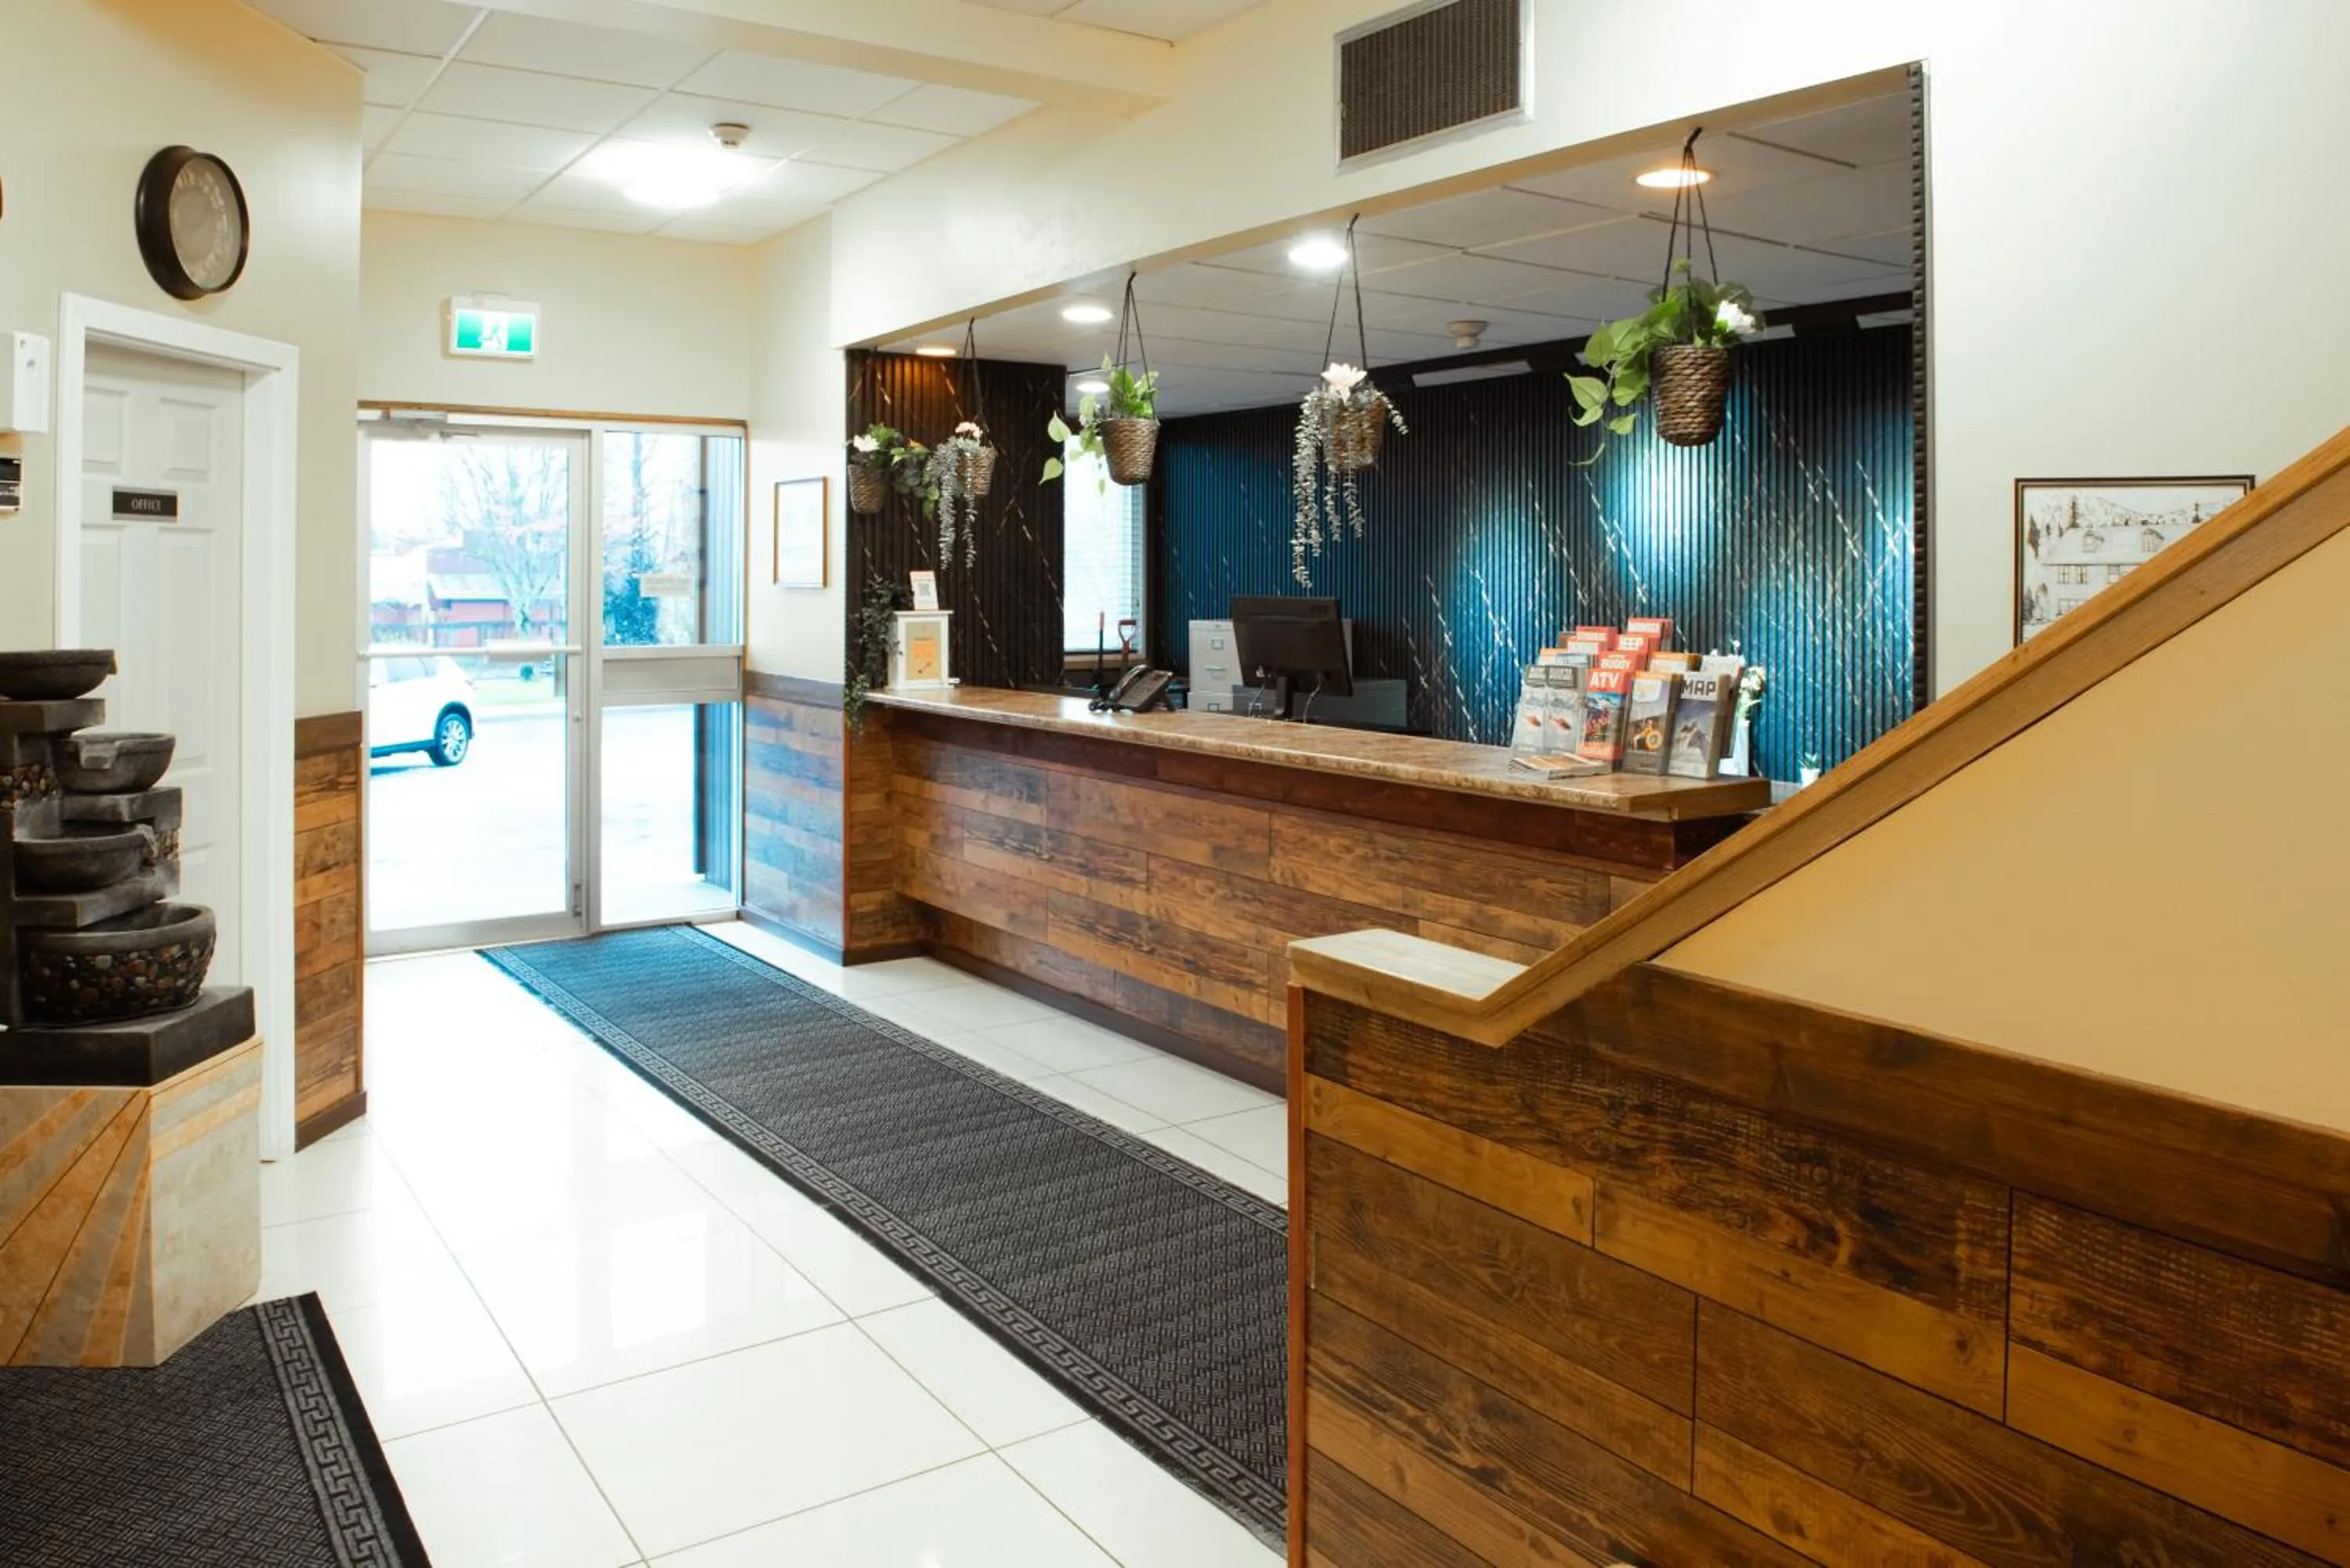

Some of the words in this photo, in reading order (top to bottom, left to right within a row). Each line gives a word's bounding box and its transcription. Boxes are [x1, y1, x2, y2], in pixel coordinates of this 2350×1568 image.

[132, 498, 161, 511] OFFICE
[1590, 670, 1619, 688] ATV
[1682, 678, 1716, 696] MAP
